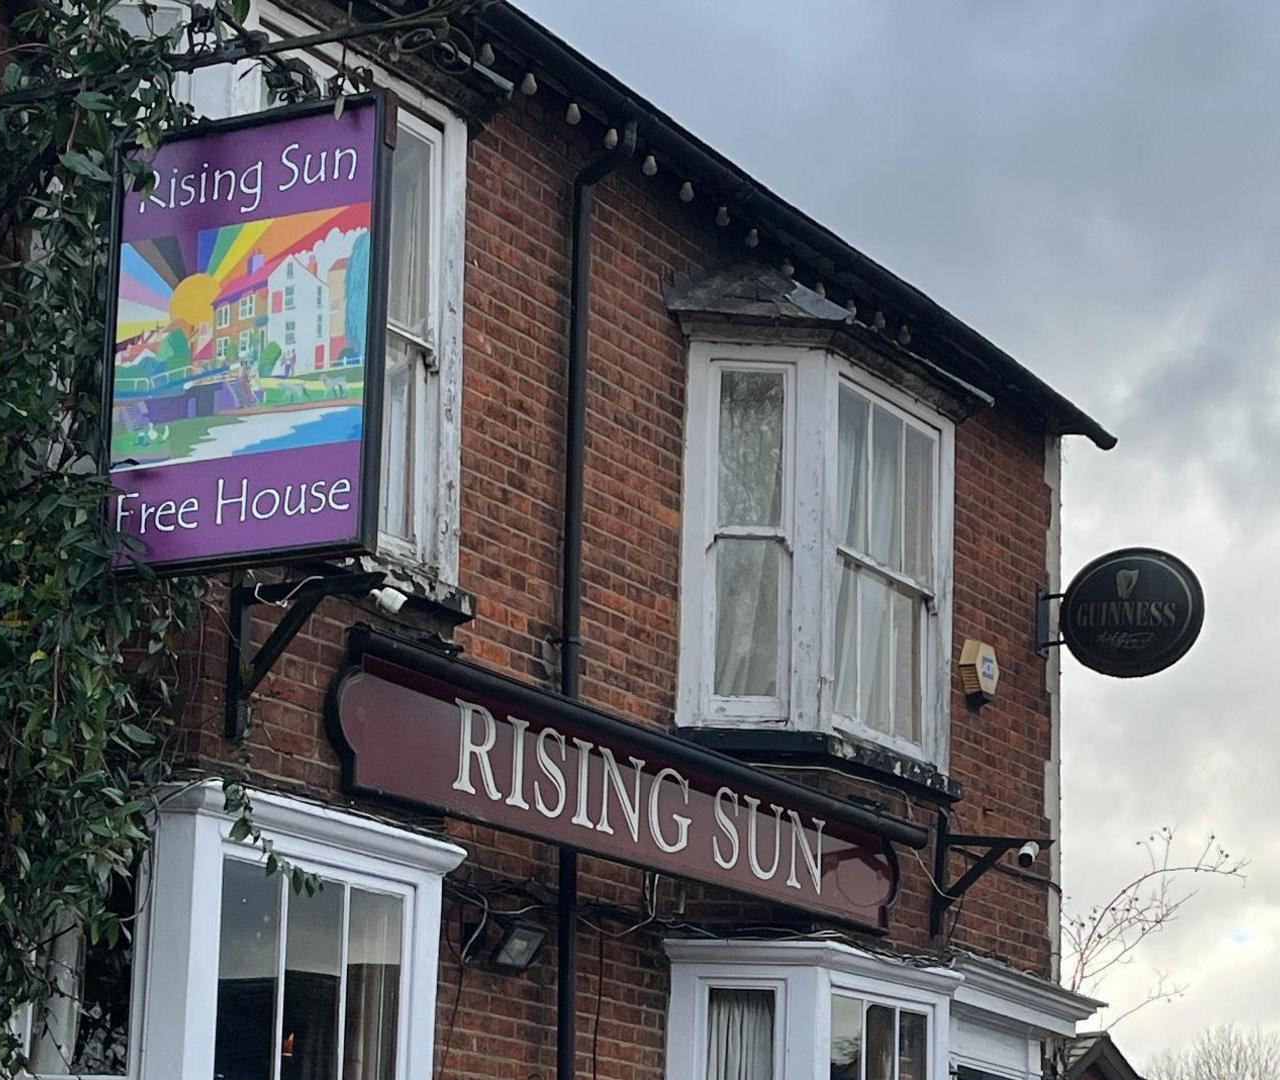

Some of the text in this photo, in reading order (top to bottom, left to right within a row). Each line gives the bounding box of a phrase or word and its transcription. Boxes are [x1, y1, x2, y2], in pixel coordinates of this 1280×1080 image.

[278, 143, 359, 192] Sun
[116, 477, 352, 534] Free House
[1077, 602, 1176, 627] GUINNESS
[452, 697, 827, 897] RISING SUN
